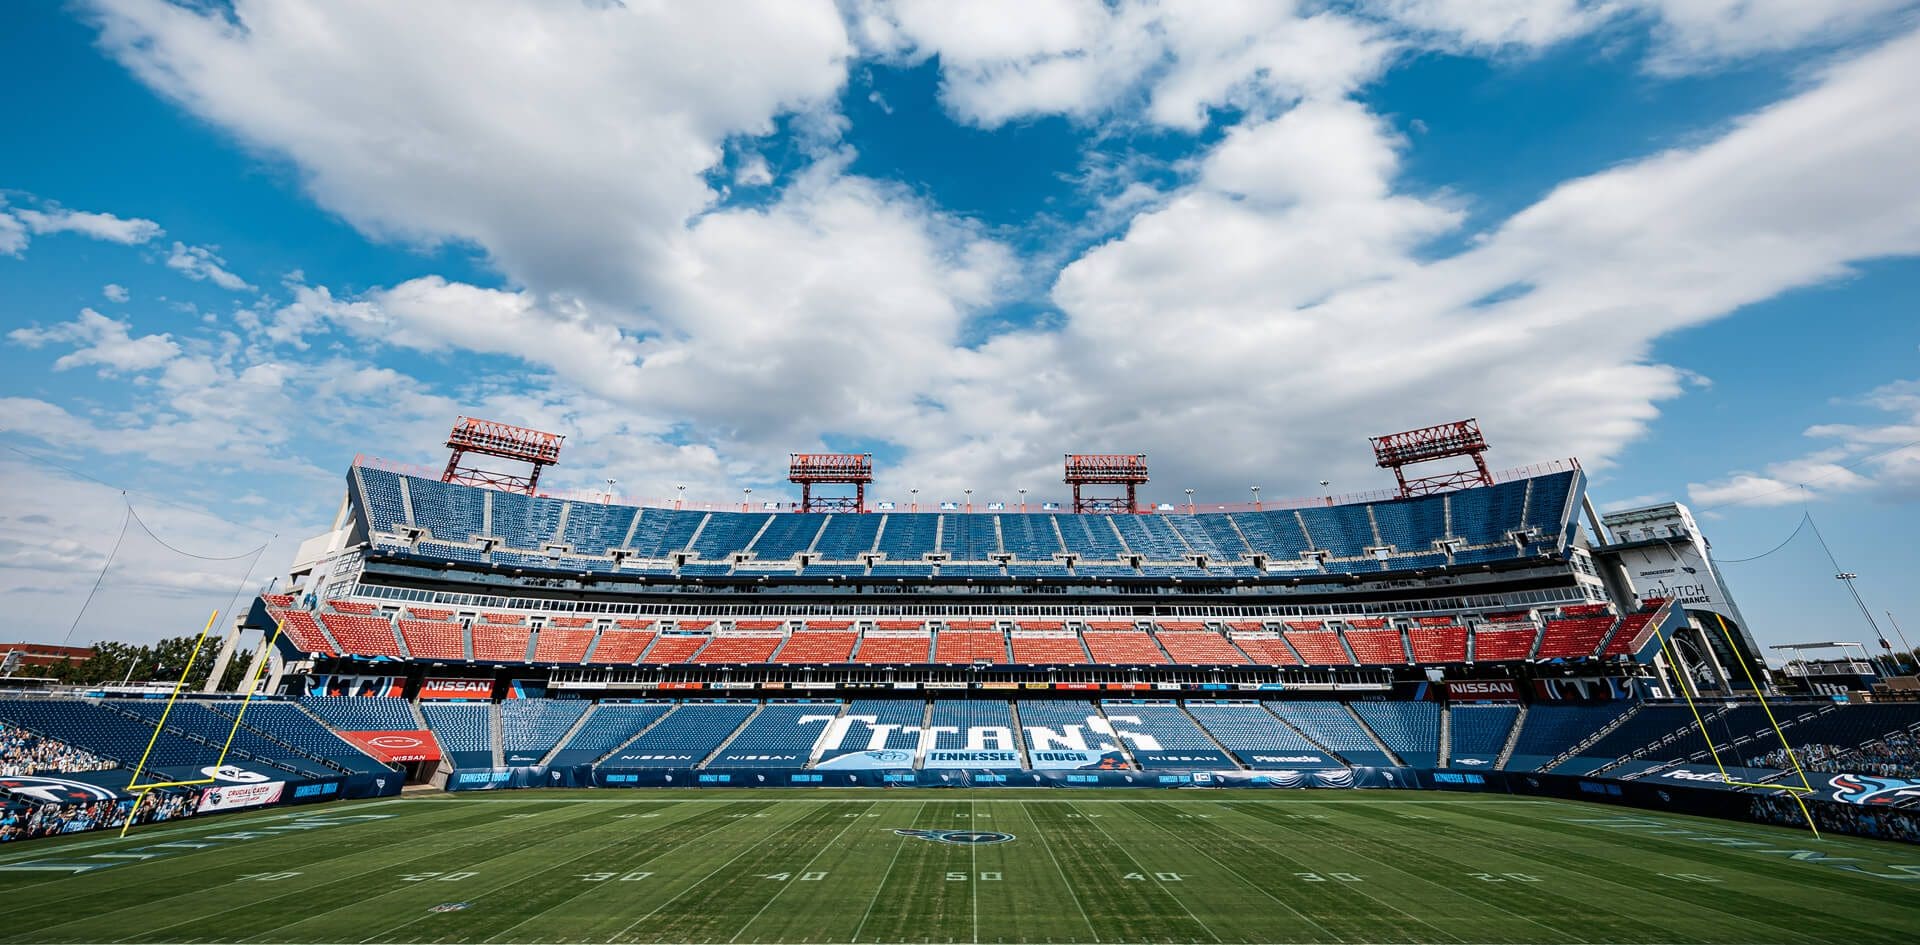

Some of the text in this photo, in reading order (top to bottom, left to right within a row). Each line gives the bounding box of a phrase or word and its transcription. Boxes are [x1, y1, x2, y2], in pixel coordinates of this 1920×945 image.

[426, 681, 490, 691] NISSAN
[1449, 682, 1514, 693] NISSAN
[798, 714, 1163, 751] TITANS
[930, 752, 1088, 761] TENNESSEE TOUGH
[459, 772, 510, 783] TENNESSEE TOUGH
[402, 872, 480, 881] 20
[582, 872, 654, 881] 30
[766, 872, 829, 881] 40
[946, 872, 1002, 881] 50
[1123, 872, 1184, 882] 40
[1294, 872, 1364, 882] 30
